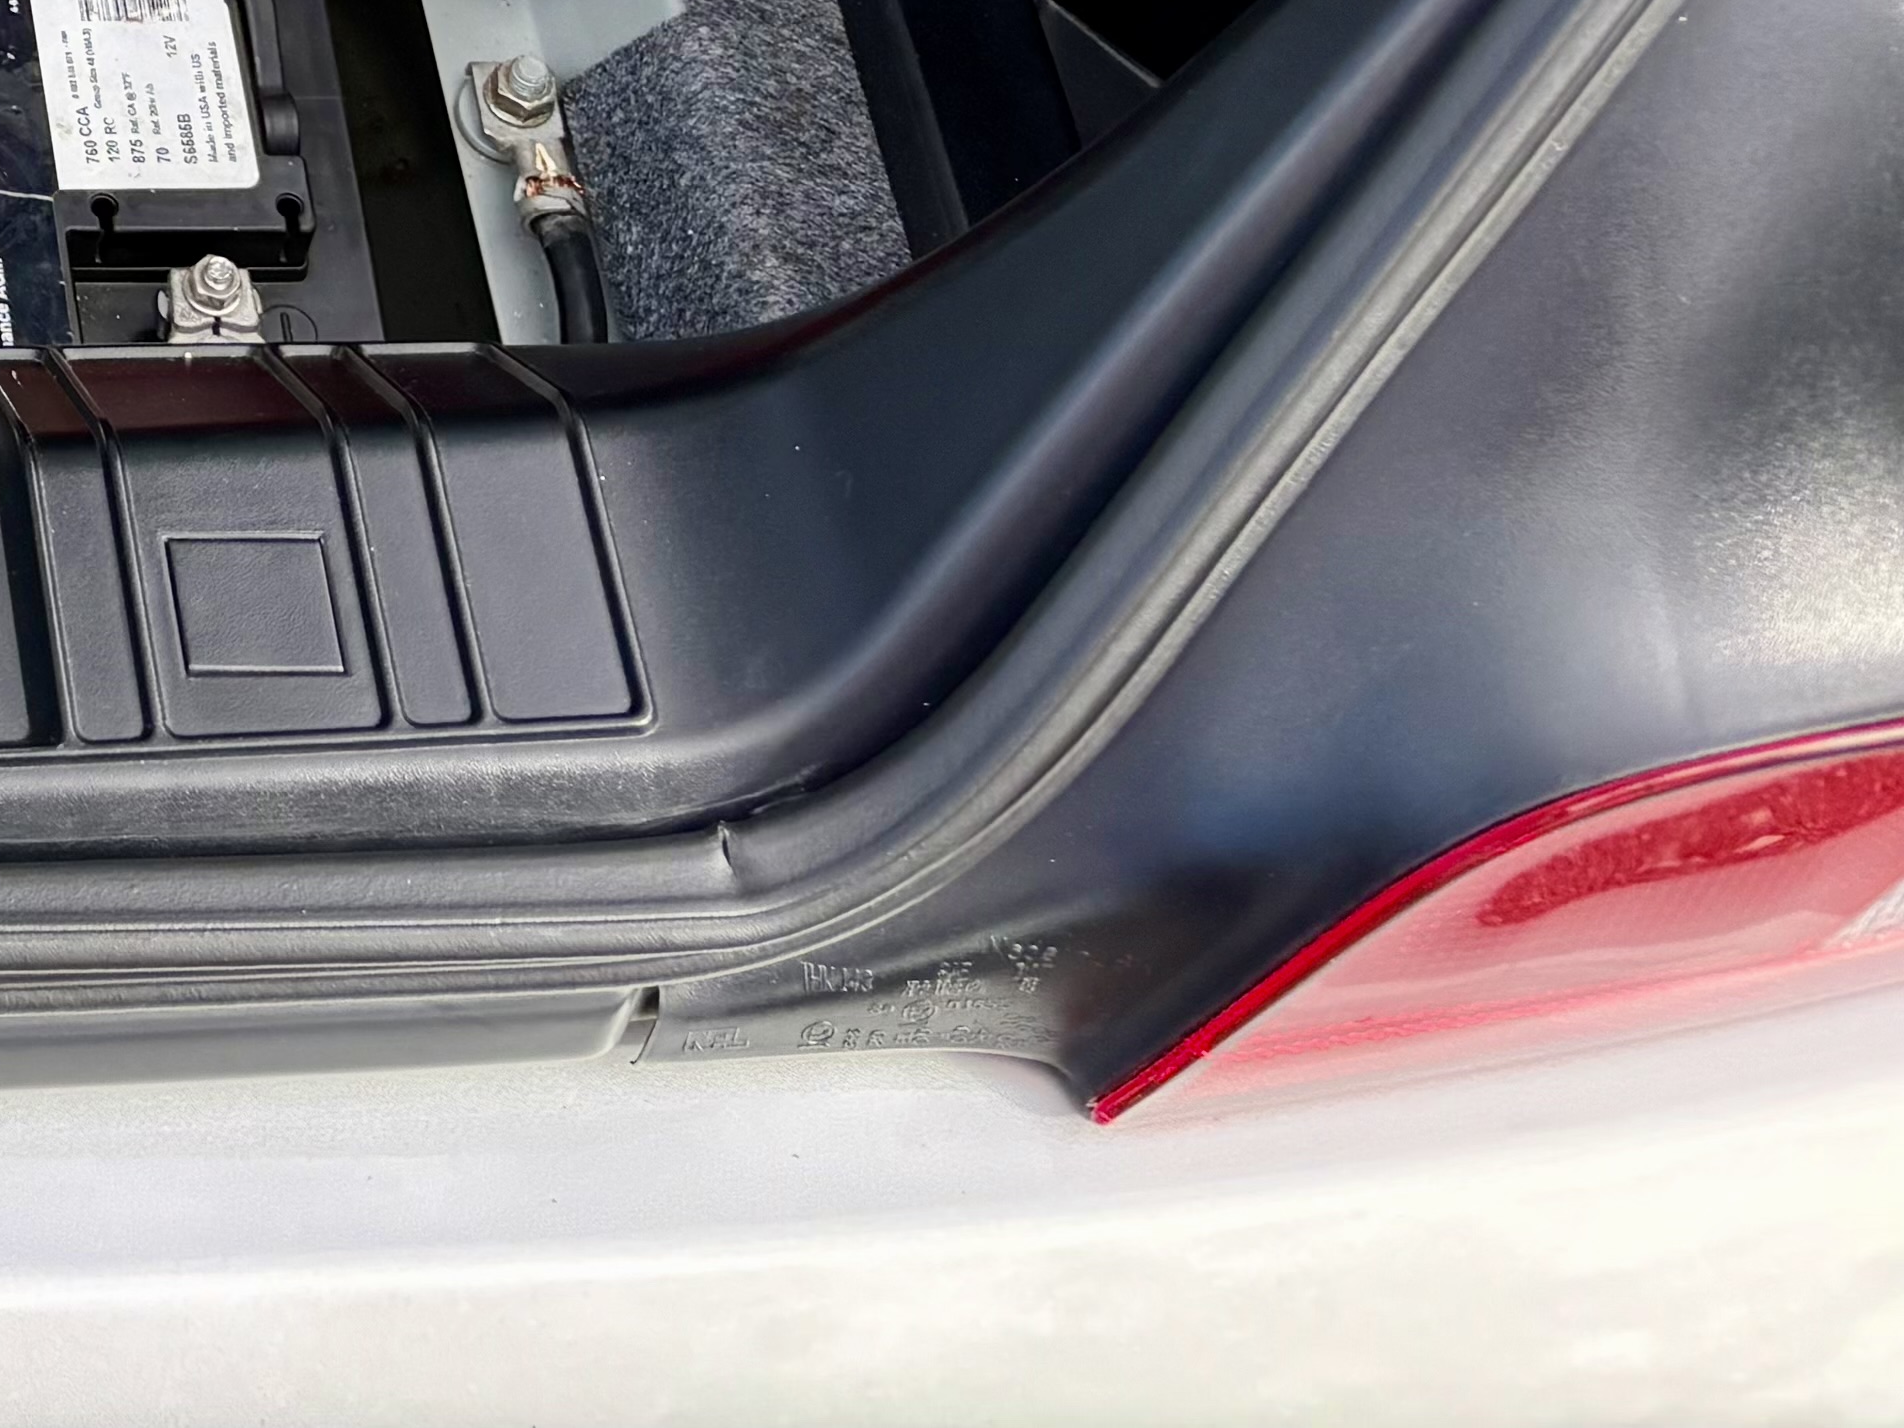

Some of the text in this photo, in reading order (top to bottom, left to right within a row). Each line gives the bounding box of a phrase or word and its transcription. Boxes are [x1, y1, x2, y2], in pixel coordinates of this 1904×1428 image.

[163, 35, 177, 58] 12V
[191, 54, 202, 68] US
[128, 103, 137, 116] CA
[198, 96, 211, 118] USA
[207, 41, 237, 162] and imported materials
[76, 106, 100, 163] 760 CCA
[204, 122, 212, 131] in
[103, 117, 121, 162] 120 RC
[129, 139, 145, 163] 875
[155, 147, 171, 163] 70
